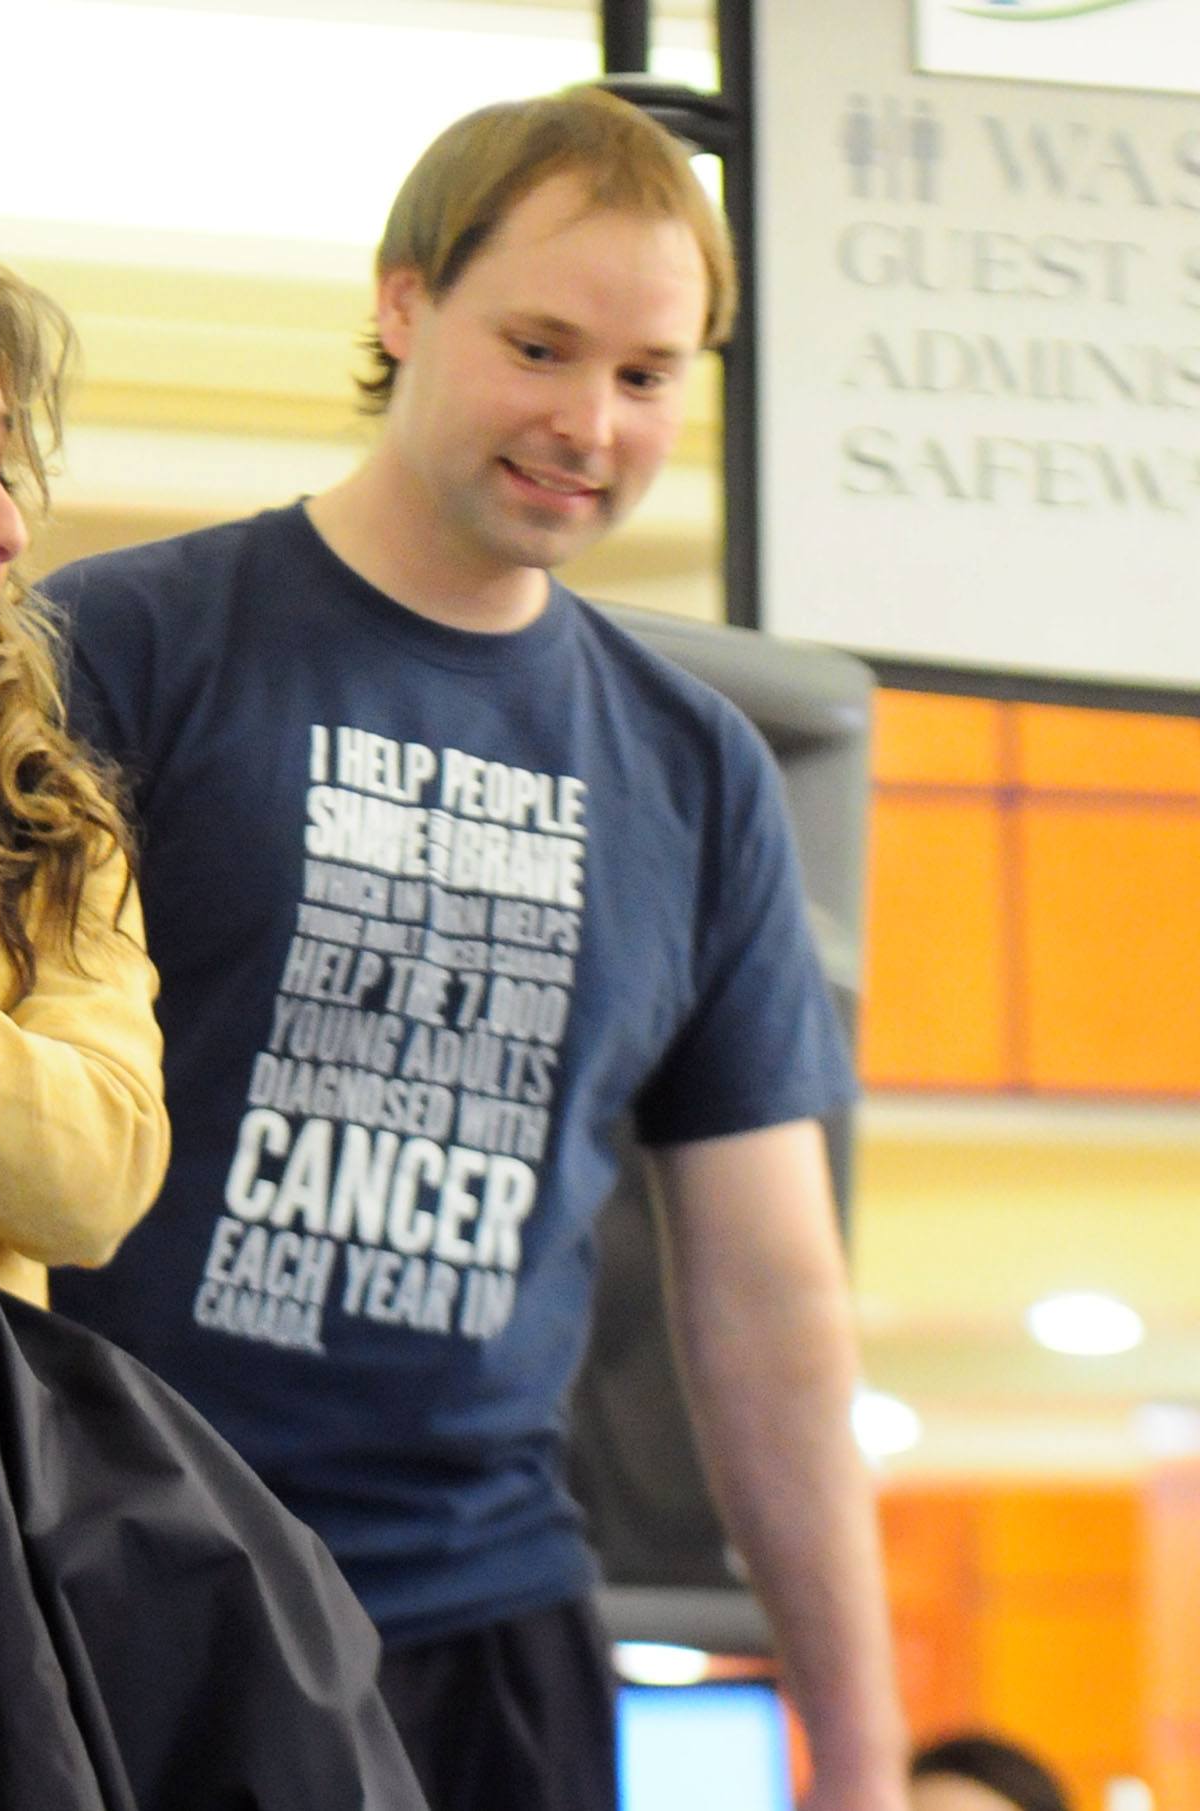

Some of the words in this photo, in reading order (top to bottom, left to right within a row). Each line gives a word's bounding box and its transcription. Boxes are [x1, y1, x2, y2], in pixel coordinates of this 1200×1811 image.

[835, 221, 1150, 305] GUEST
[840, 424, 1200, 516] SAFEW
[311, 724, 328, 783] I
[336, 725, 437, 806] HELP
[441, 747, 588, 839] PEOPLE
[305, 785, 428, 880] SHAVE
[452, 820, 585, 909] BRAVE
[280, 936, 384, 1007] HELP
[385, 956, 452, 1028] THE
[267, 995, 402, 1074] YOUNG
[400, 1023, 560, 1105] ADULTS
[247, 1051, 455, 1143] DIAGNOSED
[456, 1090, 550, 1161] WITH
[225, 1108, 537, 1272] CANCER
[193, 1283, 326, 1357] CANADA
[205, 1216, 336, 1305] EACH
[342, 1244, 460, 1335] YEAR
